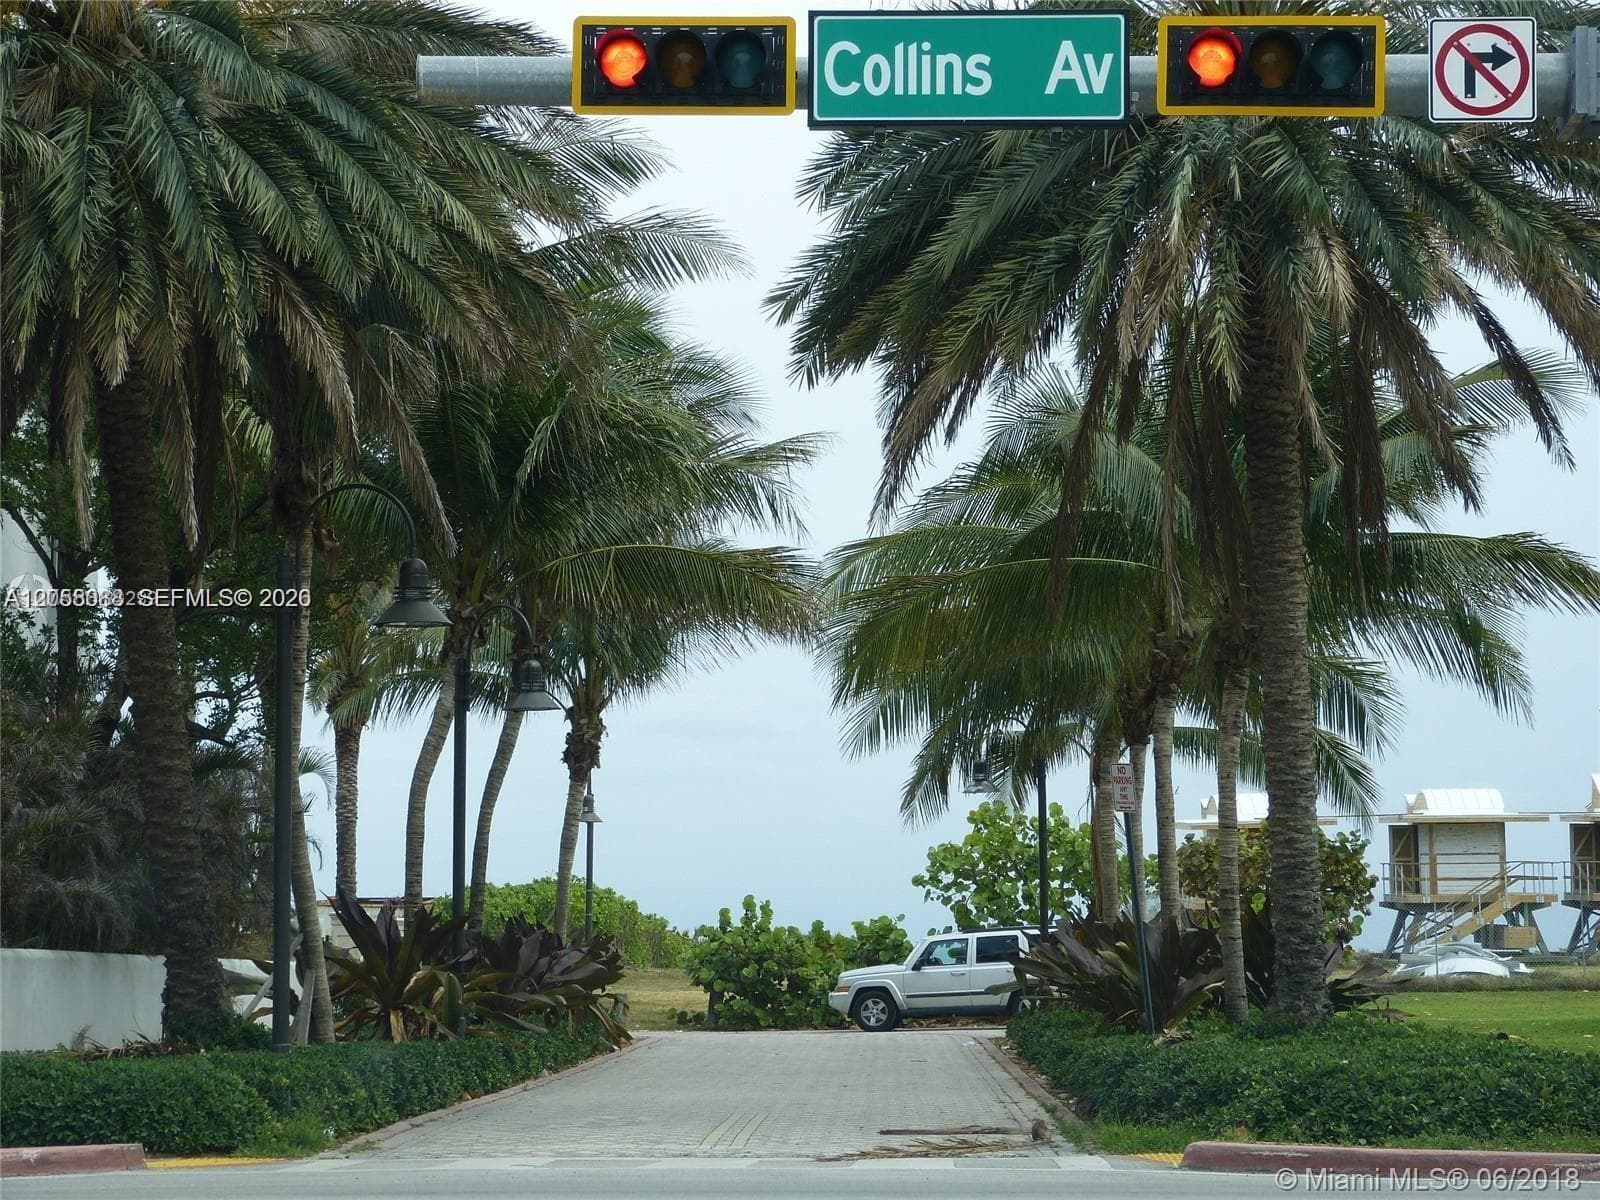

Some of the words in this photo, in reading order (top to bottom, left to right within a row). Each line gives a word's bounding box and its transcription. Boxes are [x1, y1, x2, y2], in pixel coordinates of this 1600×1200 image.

[824, 40, 993, 97] Collins
[1044, 40, 1114, 95] Av
[1117, 766, 1126, 775] NO
[1113, 776, 1132, 785] PARKING
